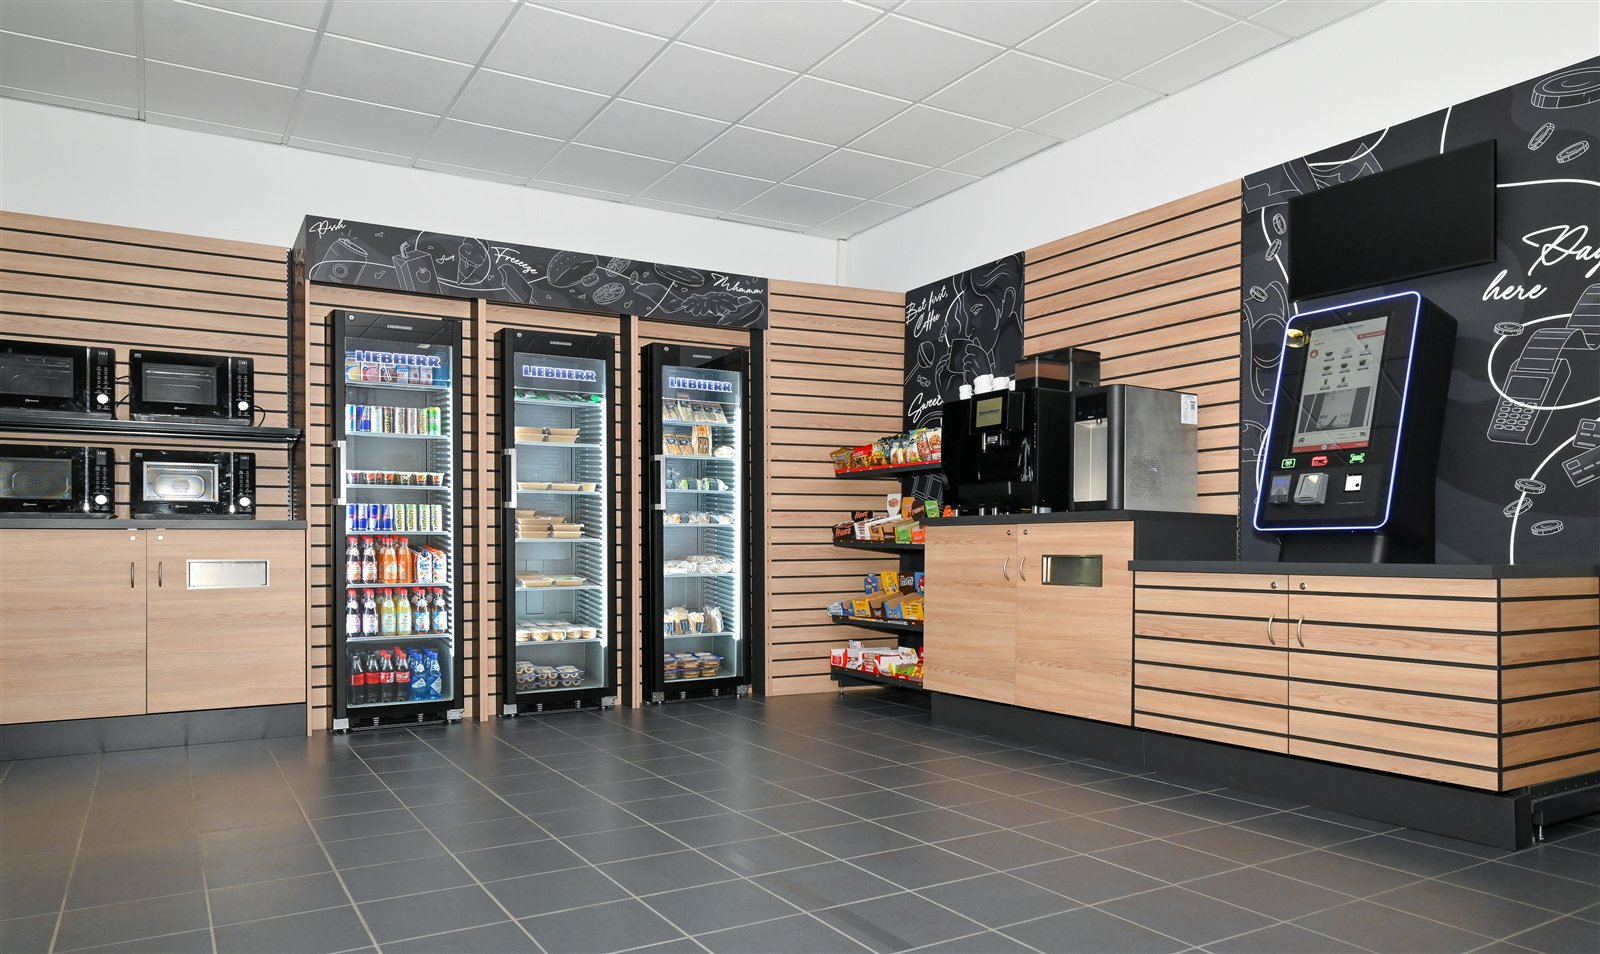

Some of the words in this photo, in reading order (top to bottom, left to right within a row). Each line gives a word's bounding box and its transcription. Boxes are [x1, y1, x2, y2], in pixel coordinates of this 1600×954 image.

[1482, 269, 1547, 301] here
[905, 298, 927, 325] But
[928, 285, 948, 311] first,
[914, 309, 940, 337] Coffee
[355, 350, 441, 368] LIEBHERR
[522, 365, 596, 382] LIEBHERR
[668, 376, 732, 393] LIEBHERR
